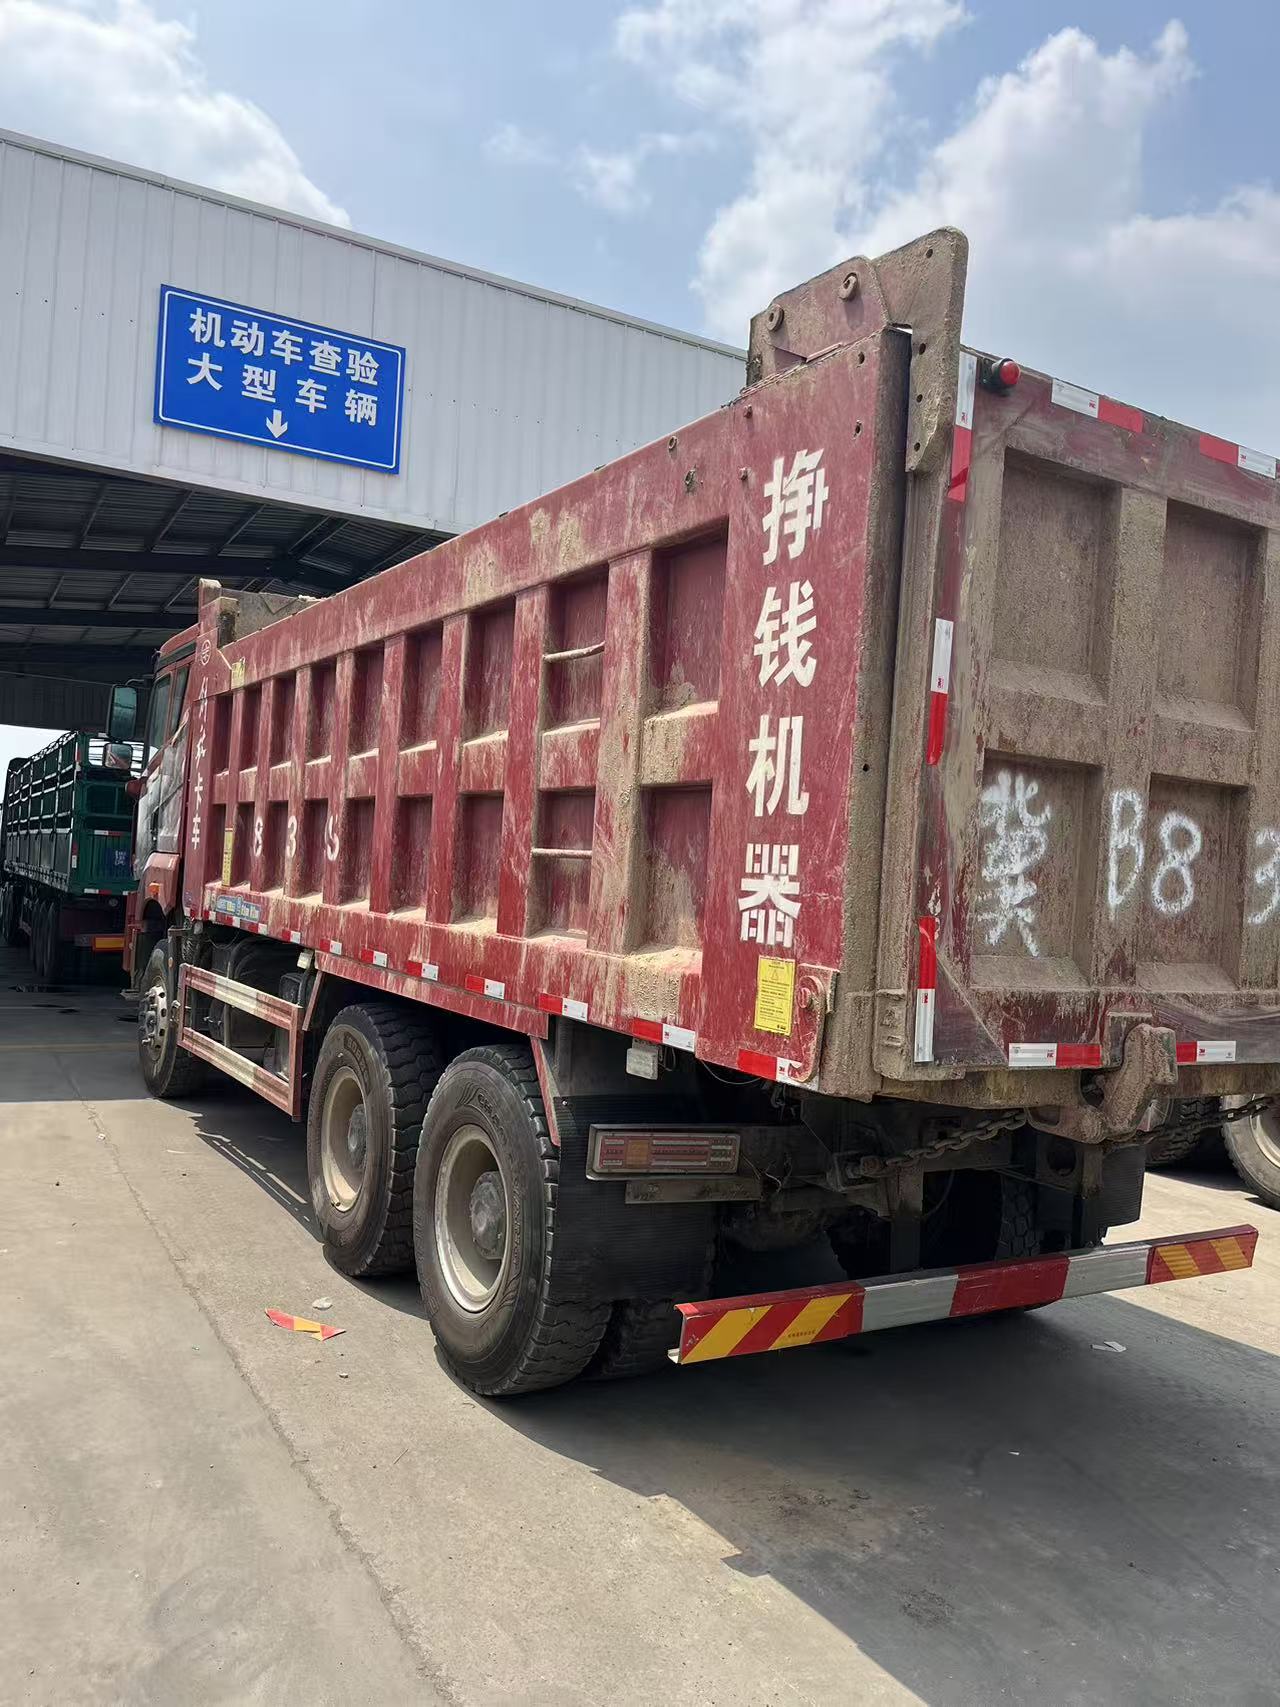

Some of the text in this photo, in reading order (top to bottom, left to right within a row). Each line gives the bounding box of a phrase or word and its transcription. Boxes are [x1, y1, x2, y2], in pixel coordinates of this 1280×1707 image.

[188, 306, 380, 386] 机动车查验
[186, 352, 378, 427] 大型车辆
[738, 448, 829, 949] 挣钱机器
